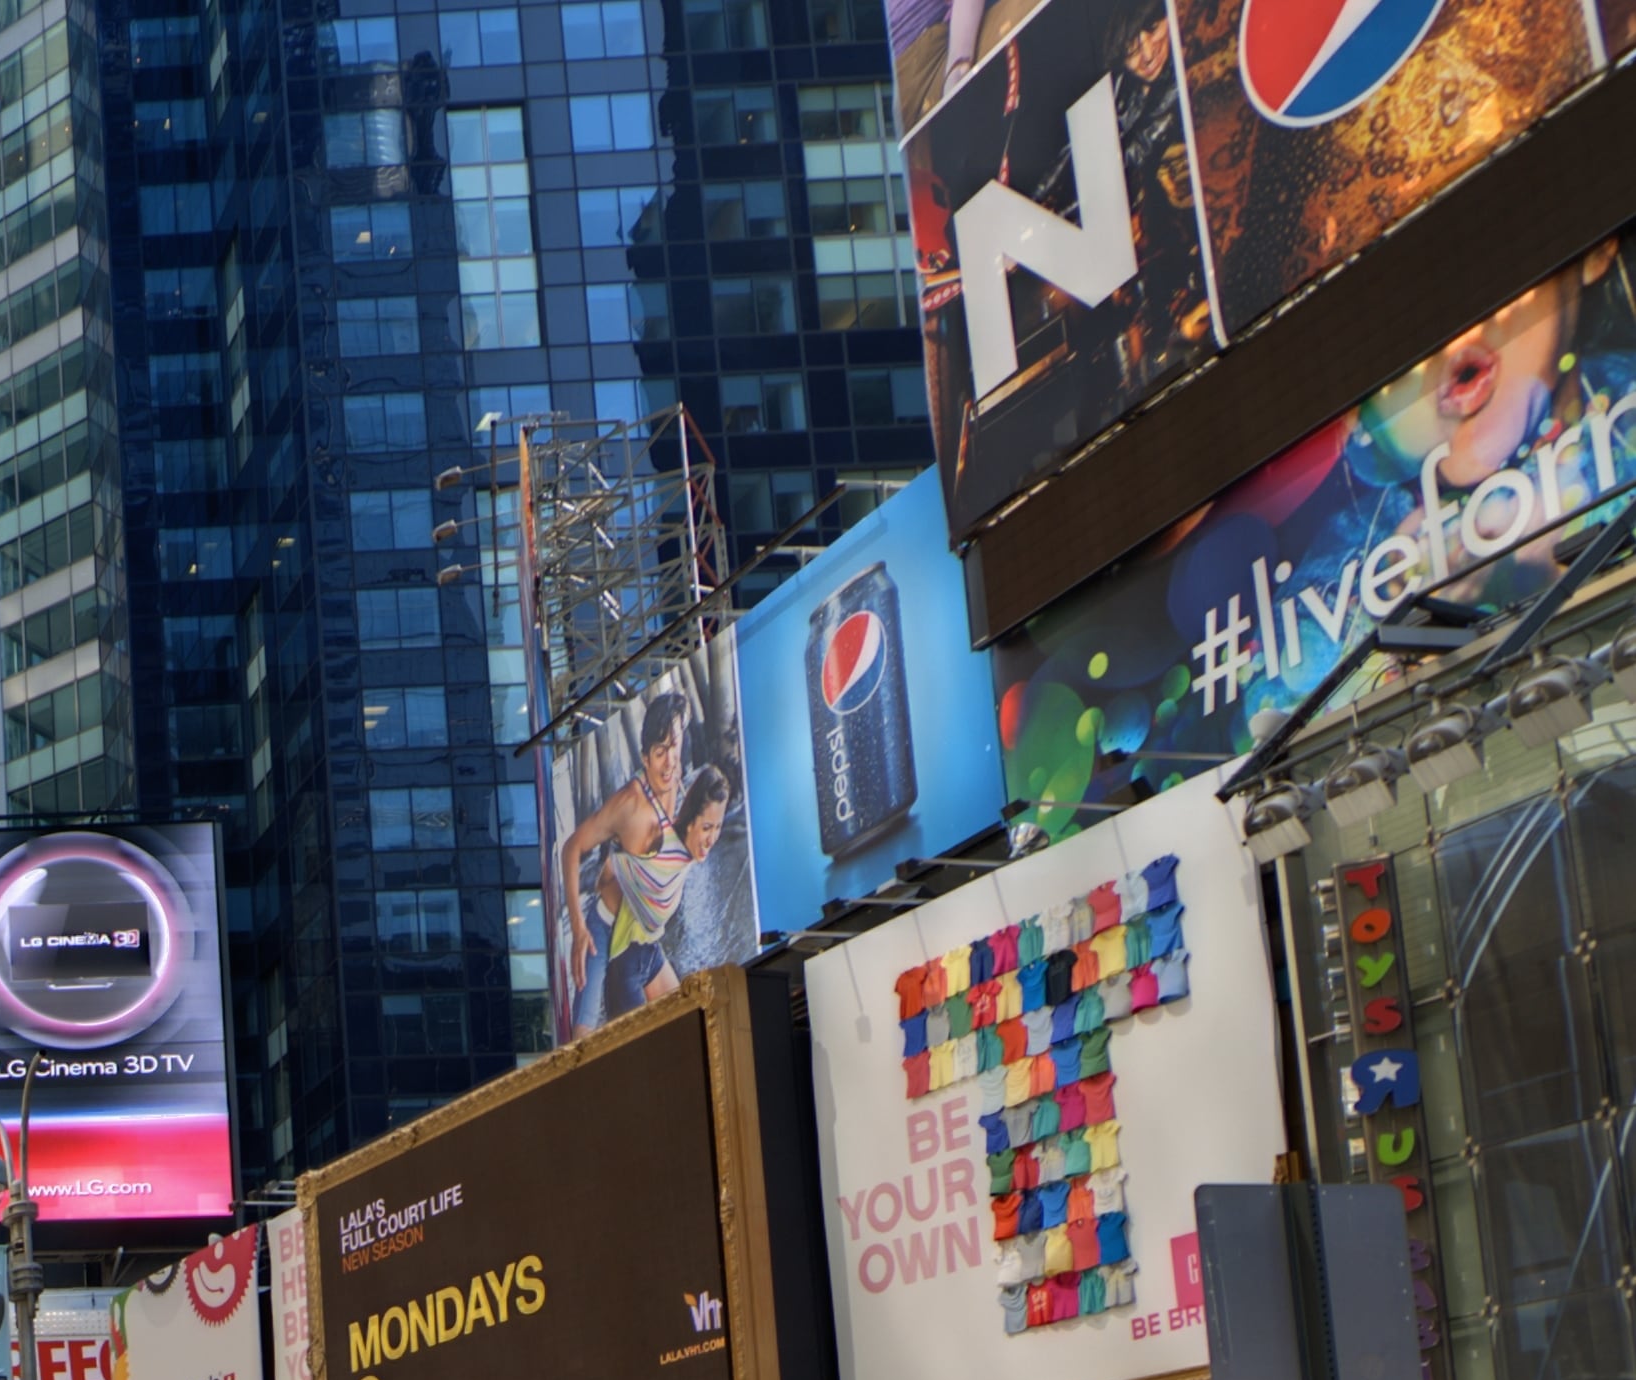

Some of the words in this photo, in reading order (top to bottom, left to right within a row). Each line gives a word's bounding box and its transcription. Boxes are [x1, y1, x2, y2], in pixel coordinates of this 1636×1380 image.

[828, 726, 854, 823] pepsi
[20, 936, 43, 948] LG
[47, 933, 110, 947] CINEMA
[114, 930, 140, 947] 3D
[1343, 862, 1403, 1035] TOYS
[34, 1057, 118, 1078] Cinema
[123, 1055, 157, 1074] 3D
[166, 1054, 194, 1072] TV
[906, 1096, 972, 1165] BE
[27, 1178, 153, 1197] www.LG.com
[339, 1198, 387, 1235] LALA'S
[836, 1155, 978, 1242] YOUR
[340, 1221, 374, 1254] FULL
[377, 1202, 428, 1240] COURT
[430, 1183, 464, 1216] LIFE
[342, 1247, 370, 1274] NEW
[372, 1226, 424, 1263] SEASON
[858, 1216, 984, 1294] OWN
[348, 1255, 546, 1373] MONDAYS
[1131, 1313, 1164, 1342] BE
[659, 1337, 725, 1365] LALA.VH1.COM
